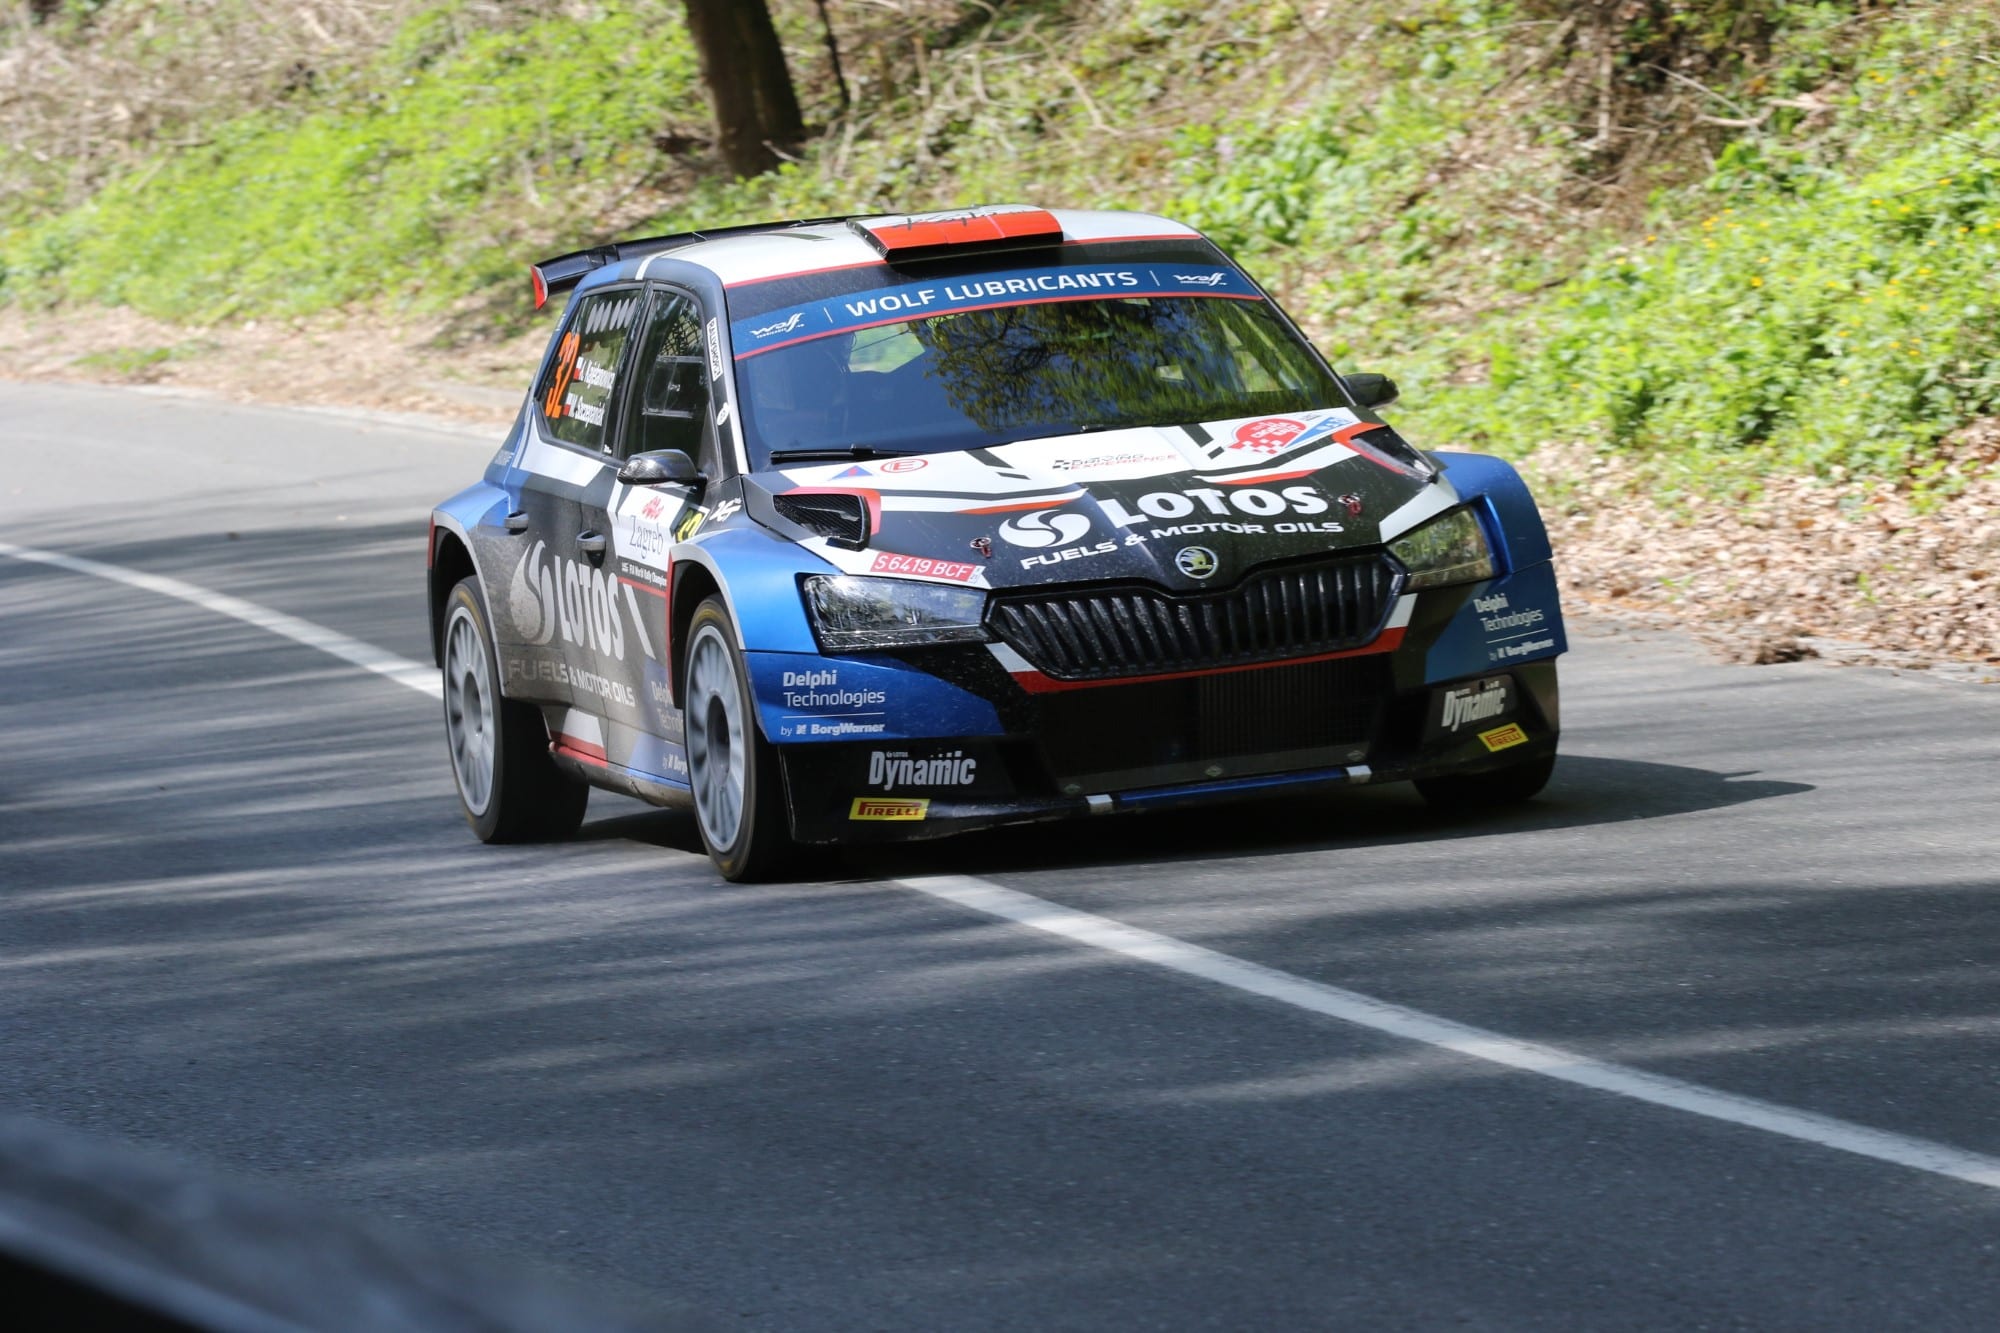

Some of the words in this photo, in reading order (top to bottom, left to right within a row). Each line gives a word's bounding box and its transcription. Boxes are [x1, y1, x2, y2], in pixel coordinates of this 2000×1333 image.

[845, 289, 935, 317] WOLF
[945, 271, 1139, 302] LUBRICANTS
[1097, 485, 1329, 528] LOTOS
[630, 515, 664, 560] Zagreb
[1019, 540, 1118, 570] FUELS
[1124, 533, 1147, 547] &
[1153, 522, 1268, 539] MOTOR
[1274, 521, 1345, 534] OILS
[874, 555, 889, 570] S
[888, 556, 932, 573] 6419
[932, 562, 973, 578] BCF
[554, 555, 625, 661] LOTOS
[1473, 593, 1509, 613] Delphi
[1480, 608, 1545, 632] Technologies
[508, 659, 569, 683] FUELS
[569, 666, 578, 687] &
[577, 668, 612, 700] MOTOR
[612, 681, 636, 708] OILS
[783, 669, 838, 689] Delphi
[783, 688, 886, 708] Technologies
[1441, 684, 1507, 732] Dynamic
[780, 725, 793, 736] by
[811, 722, 886, 736] BorgWarner
[1485, 727, 1523, 747] PIRELLI
[868, 750, 976, 791] Dynamic
[858, 801, 922, 816] PIRELLI
